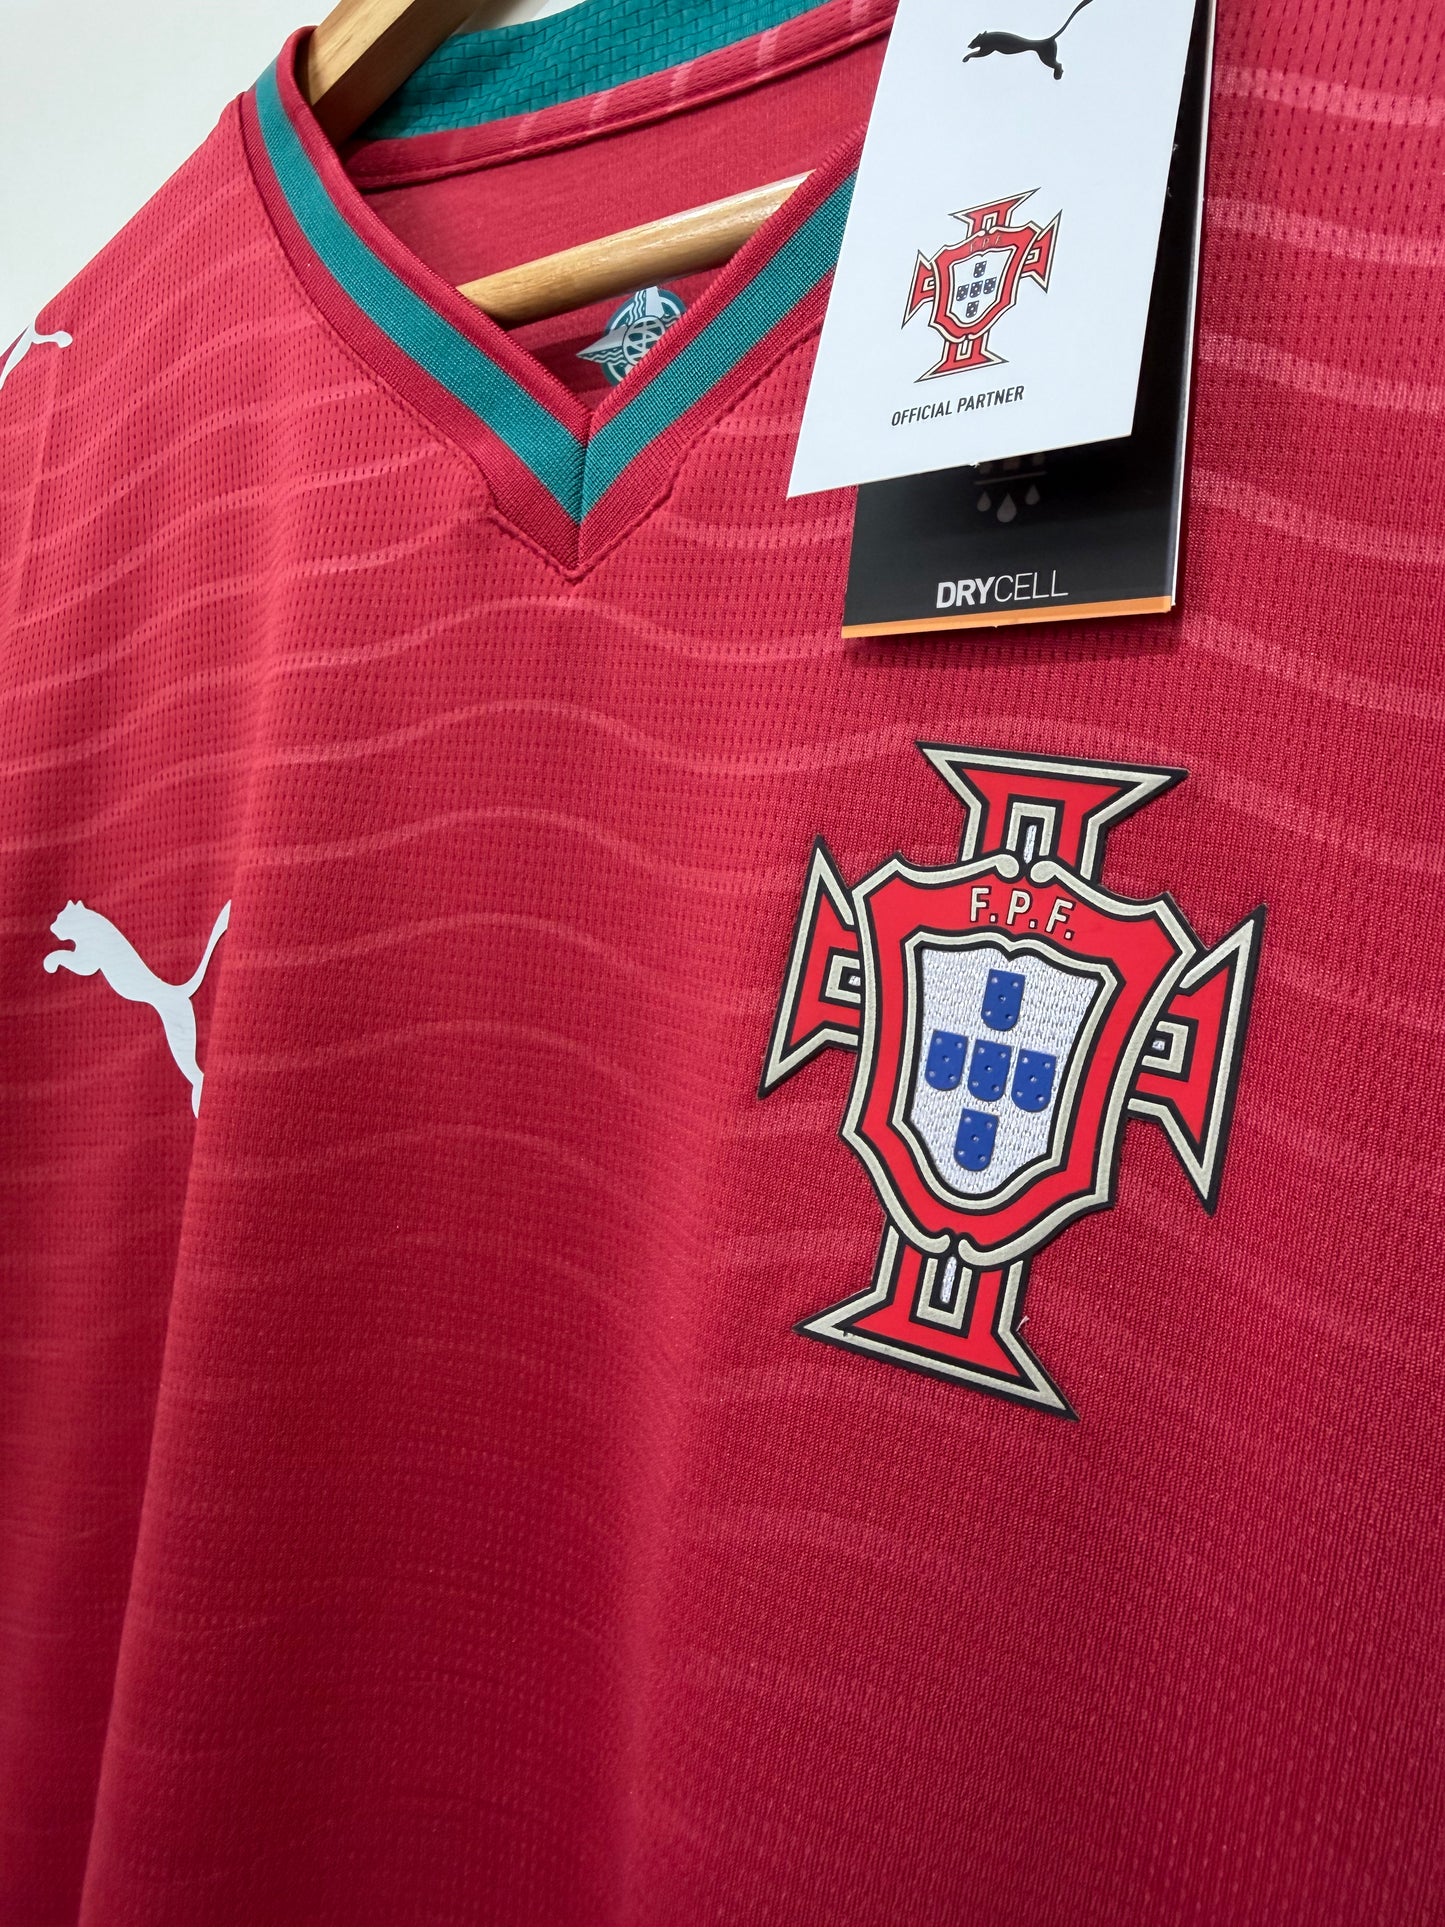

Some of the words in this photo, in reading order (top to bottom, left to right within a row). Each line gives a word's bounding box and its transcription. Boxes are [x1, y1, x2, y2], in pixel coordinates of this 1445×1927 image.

[891, 400, 953, 426] OFFICIAL
[957, 385, 1025, 413] PARTNER
[936, 569, 1069, 609] DRYCELL
[969, 886, 1074, 940] F.P.F.
